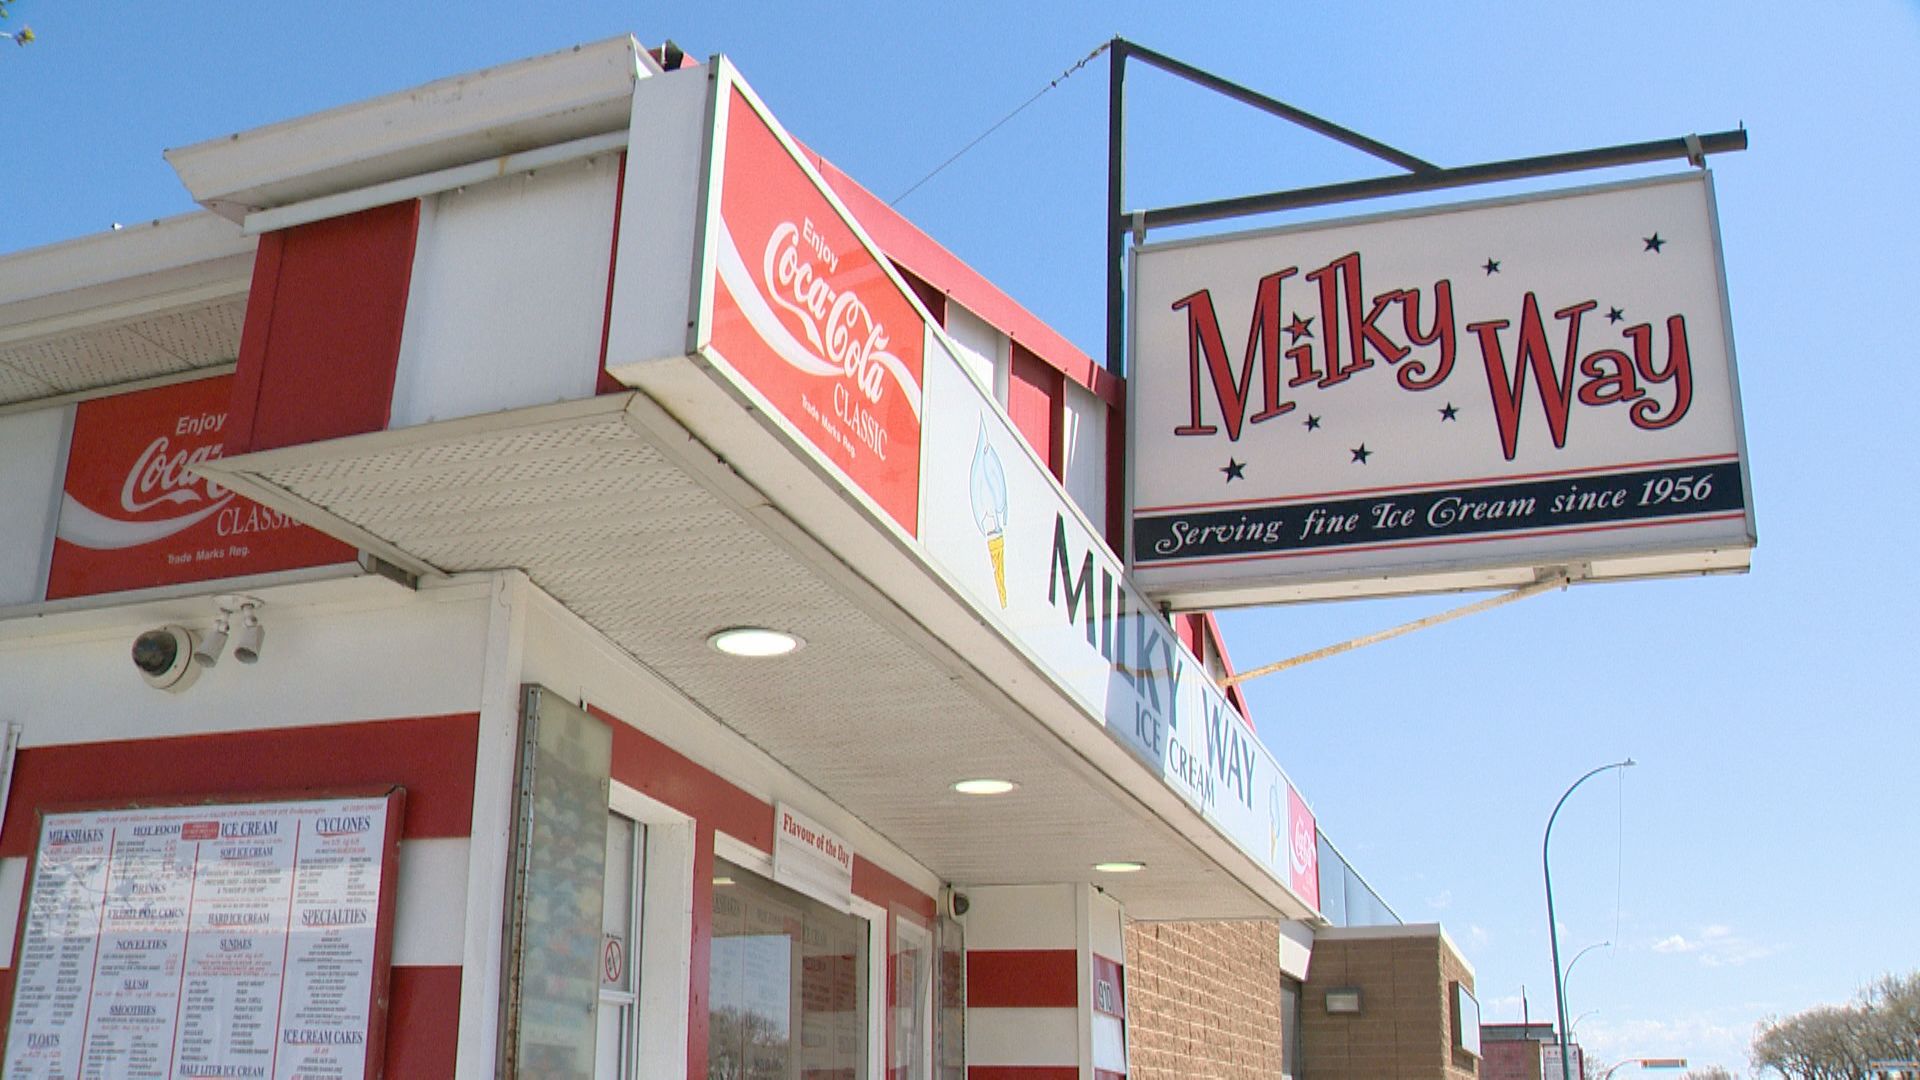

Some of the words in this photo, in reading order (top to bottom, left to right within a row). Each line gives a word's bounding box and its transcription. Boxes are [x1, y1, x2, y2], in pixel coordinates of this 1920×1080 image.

[803, 217, 838, 273] Enjoy
[763, 222, 889, 404] Coca-Cola
[1172, 251, 1457, 442] Milky
[1467, 291, 1694, 461] Way
[176, 413, 227, 436] Enjoy
[802, 393, 819, 422] Trade
[821, 413, 841, 443] Marks
[834, 383, 887, 461] CLASSIC
[1154, 519, 1283, 555] Serving
[1300, 504, 1359, 541] fine
[1371, 500, 1415, 530] Ice
[1427, 495, 1536, 529] Cream
[1551, 485, 1626, 513] since
[1639, 473, 1714, 506] 1956
[168, 554, 192, 565] Trade
[195, 548, 225, 561] Marks
[1048, 510, 1184, 733] MILKY
[1201, 686, 1256, 811] WAY
[1136, 701, 1161, 757] ICE
[1169, 736, 1215, 809] CREAM
[133, 825, 152, 836] HOT
[154, 824, 181, 836] FOOD
[221, 822, 238, 837] ICE
[240, 820, 278, 836] CREAM
[315, 815, 371, 833] CYCLONES
[49, 828, 104, 843] MILKSHAKES
[783, 812, 816, 847] Flavour
[816, 834, 825, 851] of
[825, 839, 836, 858] the
[837, 844, 850, 869] Day
[249, 846, 273, 857] CREAM
[243, 912, 270, 924] CREAM
[302, 908, 367, 925] SPECIALTIES
[116, 939, 168, 950] NOVELTIES
[219, 939, 252, 950] SUNDAES
[124, 979, 149, 990] SLUSH
[109, 1004, 157, 1016] SMOOTHIES
[27, 1033, 60, 1047] FLOATS
[283, 1028, 299, 1043] ICE
[300, 1029, 333, 1045] CREAM
[334, 1030, 364, 1044] CAKES
[180, 1064, 200, 1076] HALF
[200, 1065, 222, 1076] LITER
[223, 1065, 237, 1077] ICE
[237, 1066, 265, 1078] CREAM
